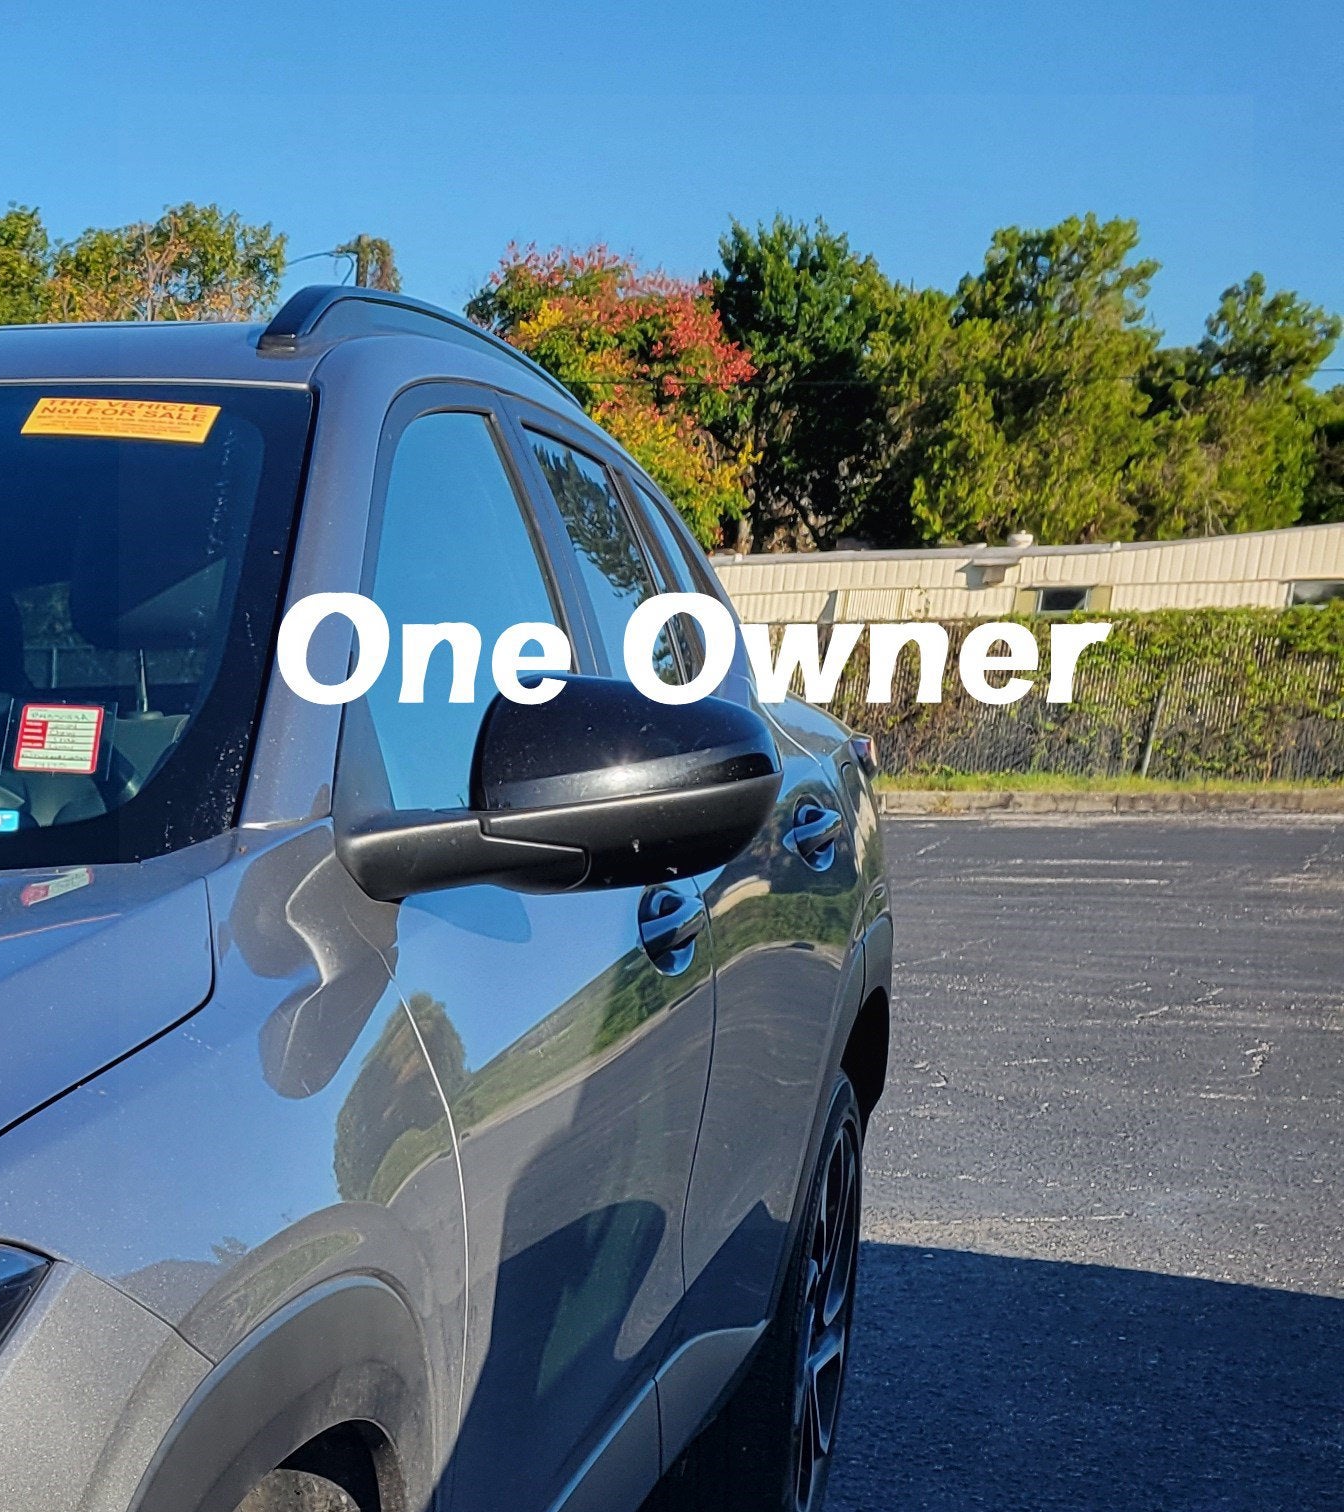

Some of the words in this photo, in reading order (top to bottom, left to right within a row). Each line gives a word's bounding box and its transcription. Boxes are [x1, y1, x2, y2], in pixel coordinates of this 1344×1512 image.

[48, 399, 98, 407] THIS
[107, 401, 208, 414] VEHICLE
[85, 408, 136, 417] FOR
[142, 410, 207, 423] SALE
